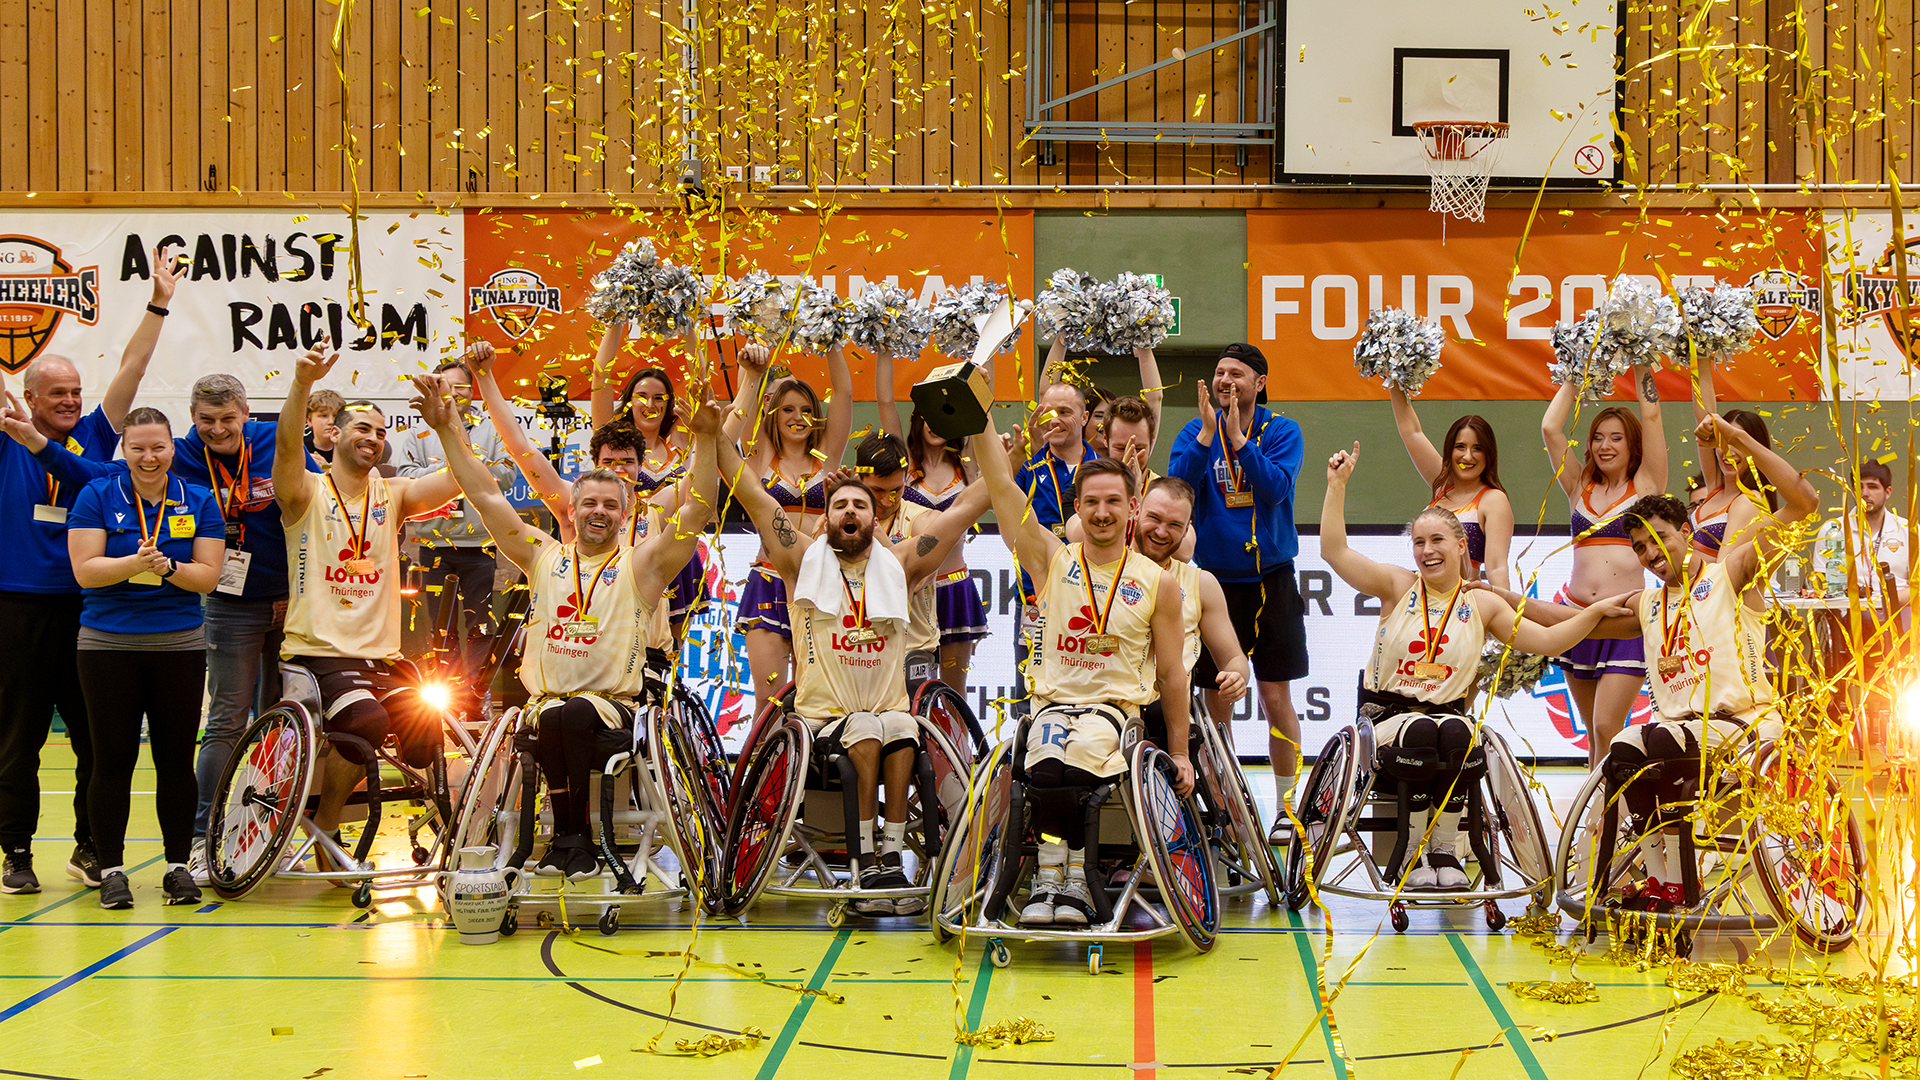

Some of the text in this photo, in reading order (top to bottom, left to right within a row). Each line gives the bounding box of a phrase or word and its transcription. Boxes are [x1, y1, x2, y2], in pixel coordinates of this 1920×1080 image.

[120, 232, 344, 283] AGAINST
[471, 288, 561, 312] FINAL FOUR
[11, 314, 34, 322] 1967
[228, 302, 430, 352] RACISM
[330, 585, 374, 599] Thüringen
[1033, 616, 1047, 666] JÜTTNER
[1056, 633, 1114, 657] LOT
[547, 643, 589, 659] Thüringen
[838, 654, 882, 669] Thüringen
[1060, 655, 1106, 671] Thüringen
[1399, 678, 1442, 692] Thüringen
[1042, 722, 1069, 750] 12
[454, 881, 504, 893] SPORTSTADT
